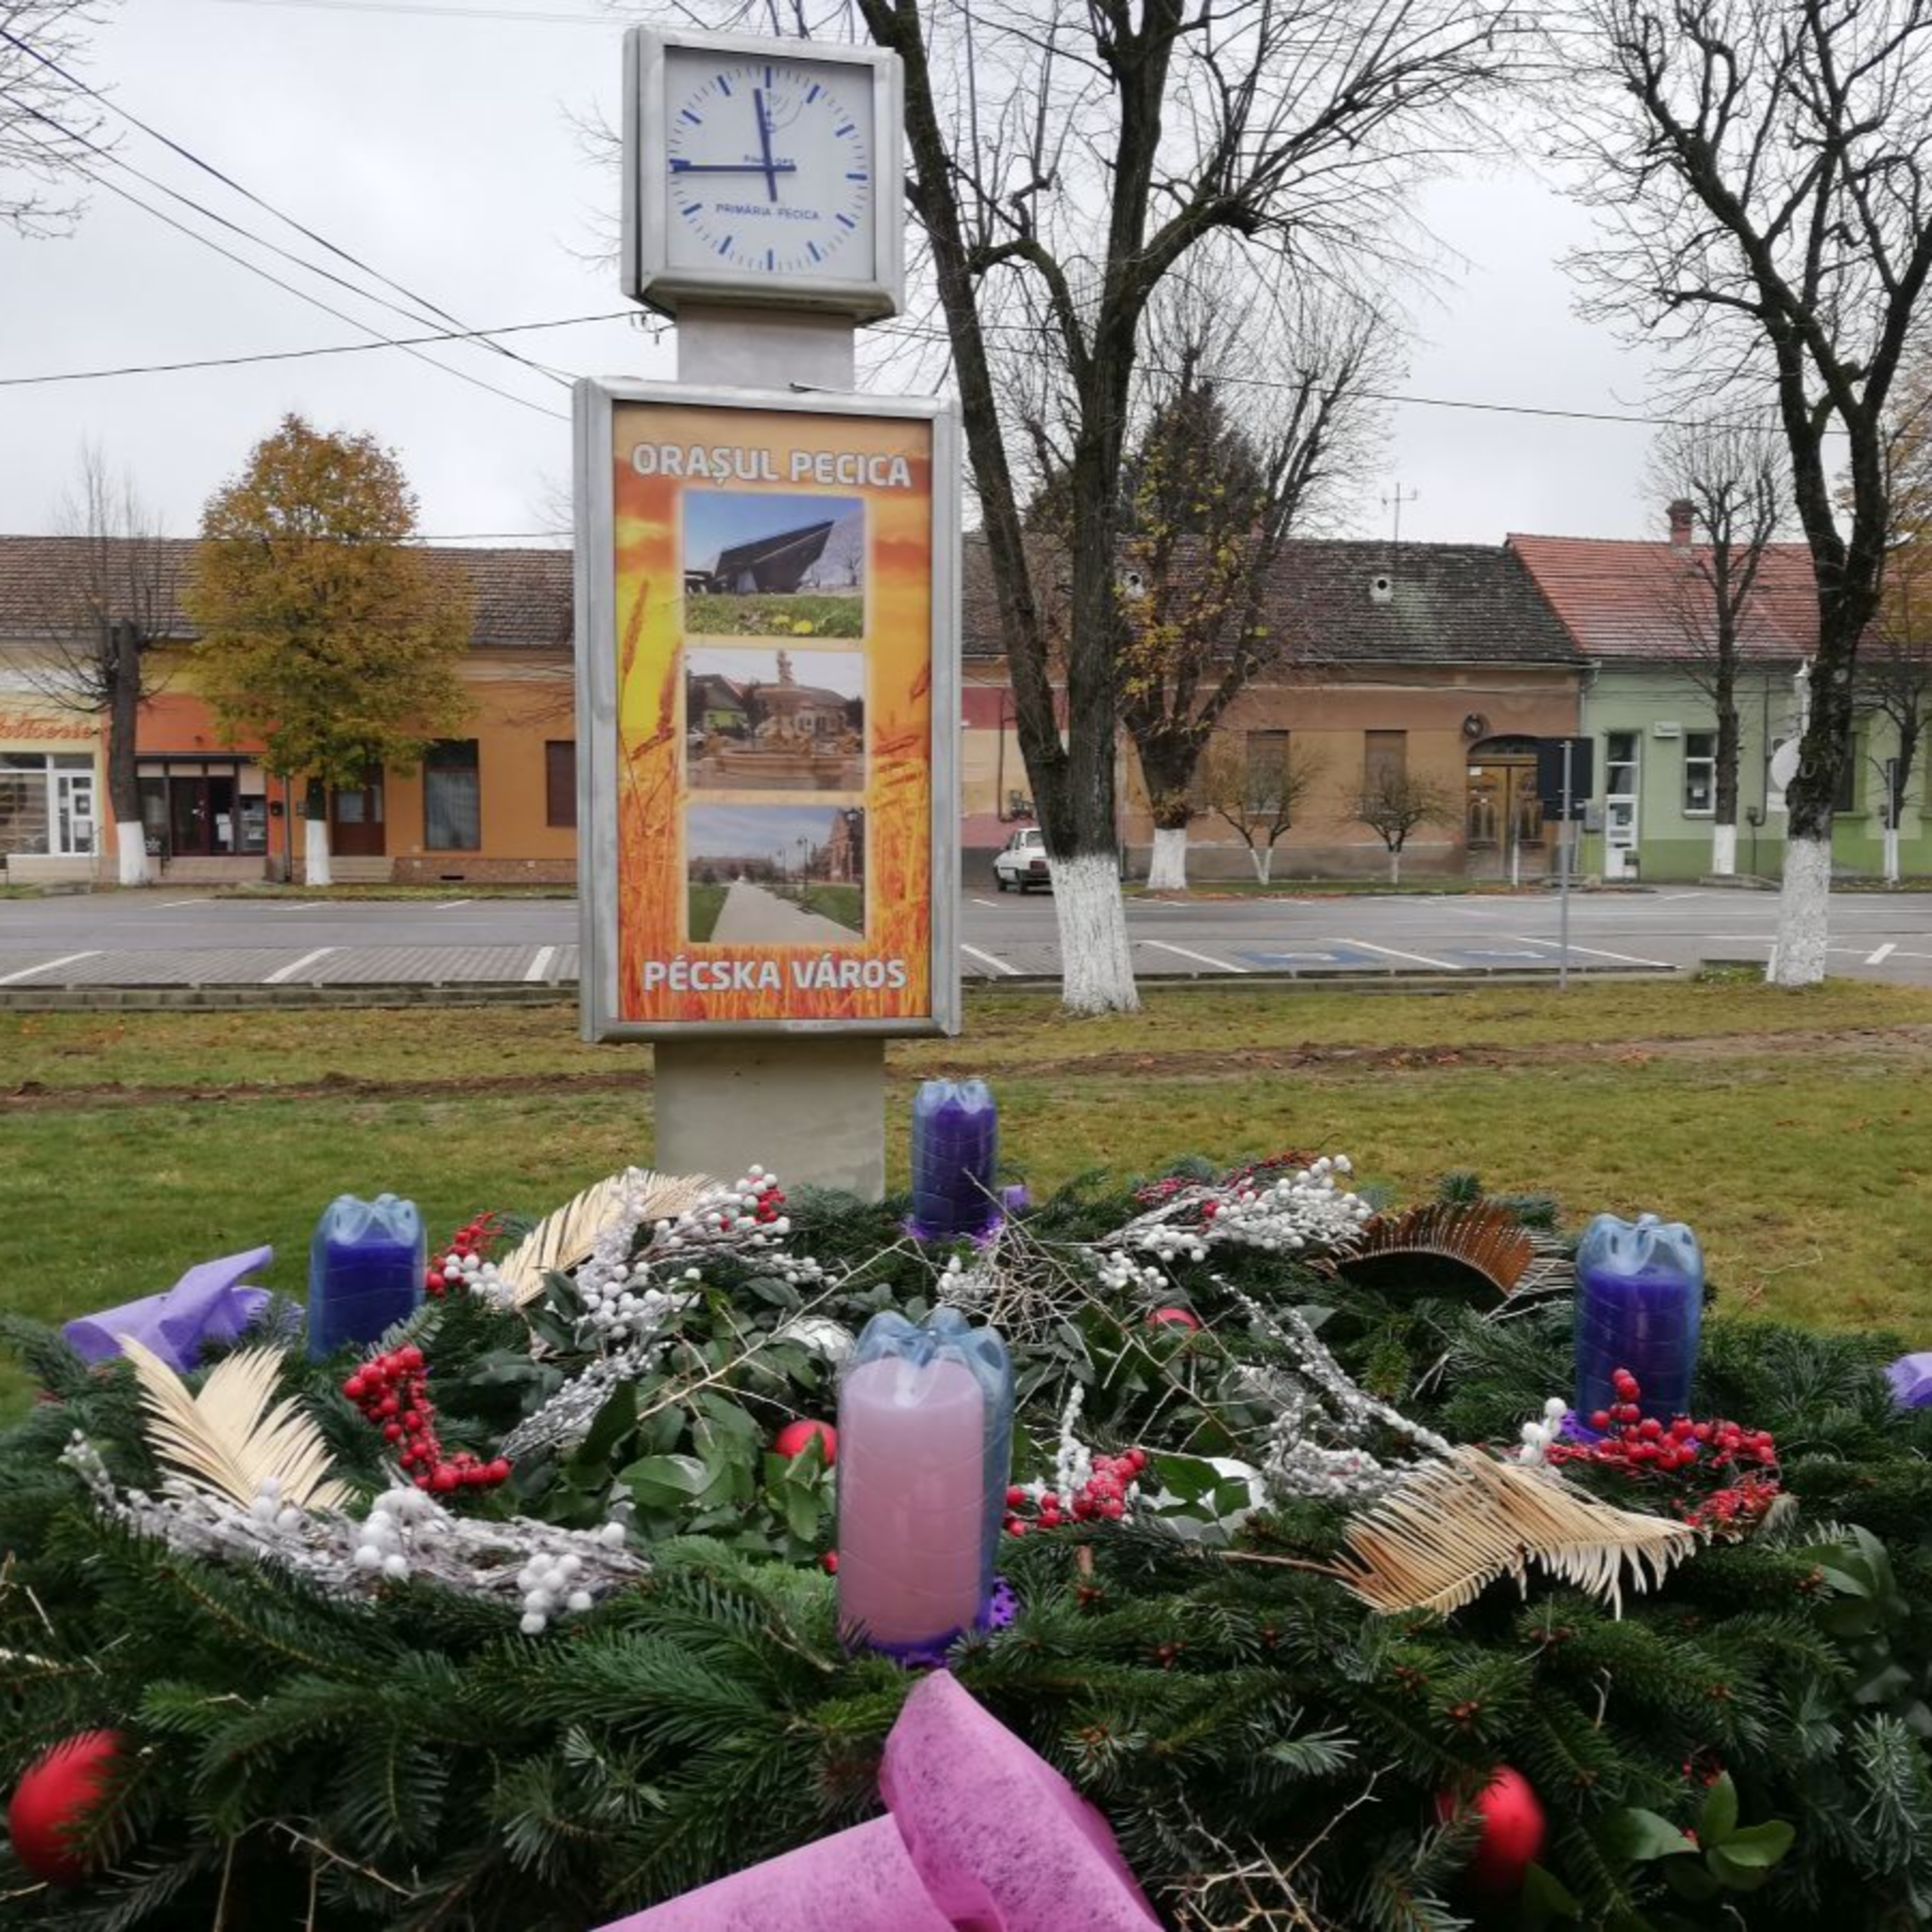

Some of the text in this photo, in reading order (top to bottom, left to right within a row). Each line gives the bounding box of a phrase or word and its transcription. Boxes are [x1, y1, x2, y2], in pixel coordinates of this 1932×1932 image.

[778, 207, 819, 220] PECICA
[790, 451, 912, 488] PECICA
[644, 953, 907, 990] PÉCSKA VÁROS
